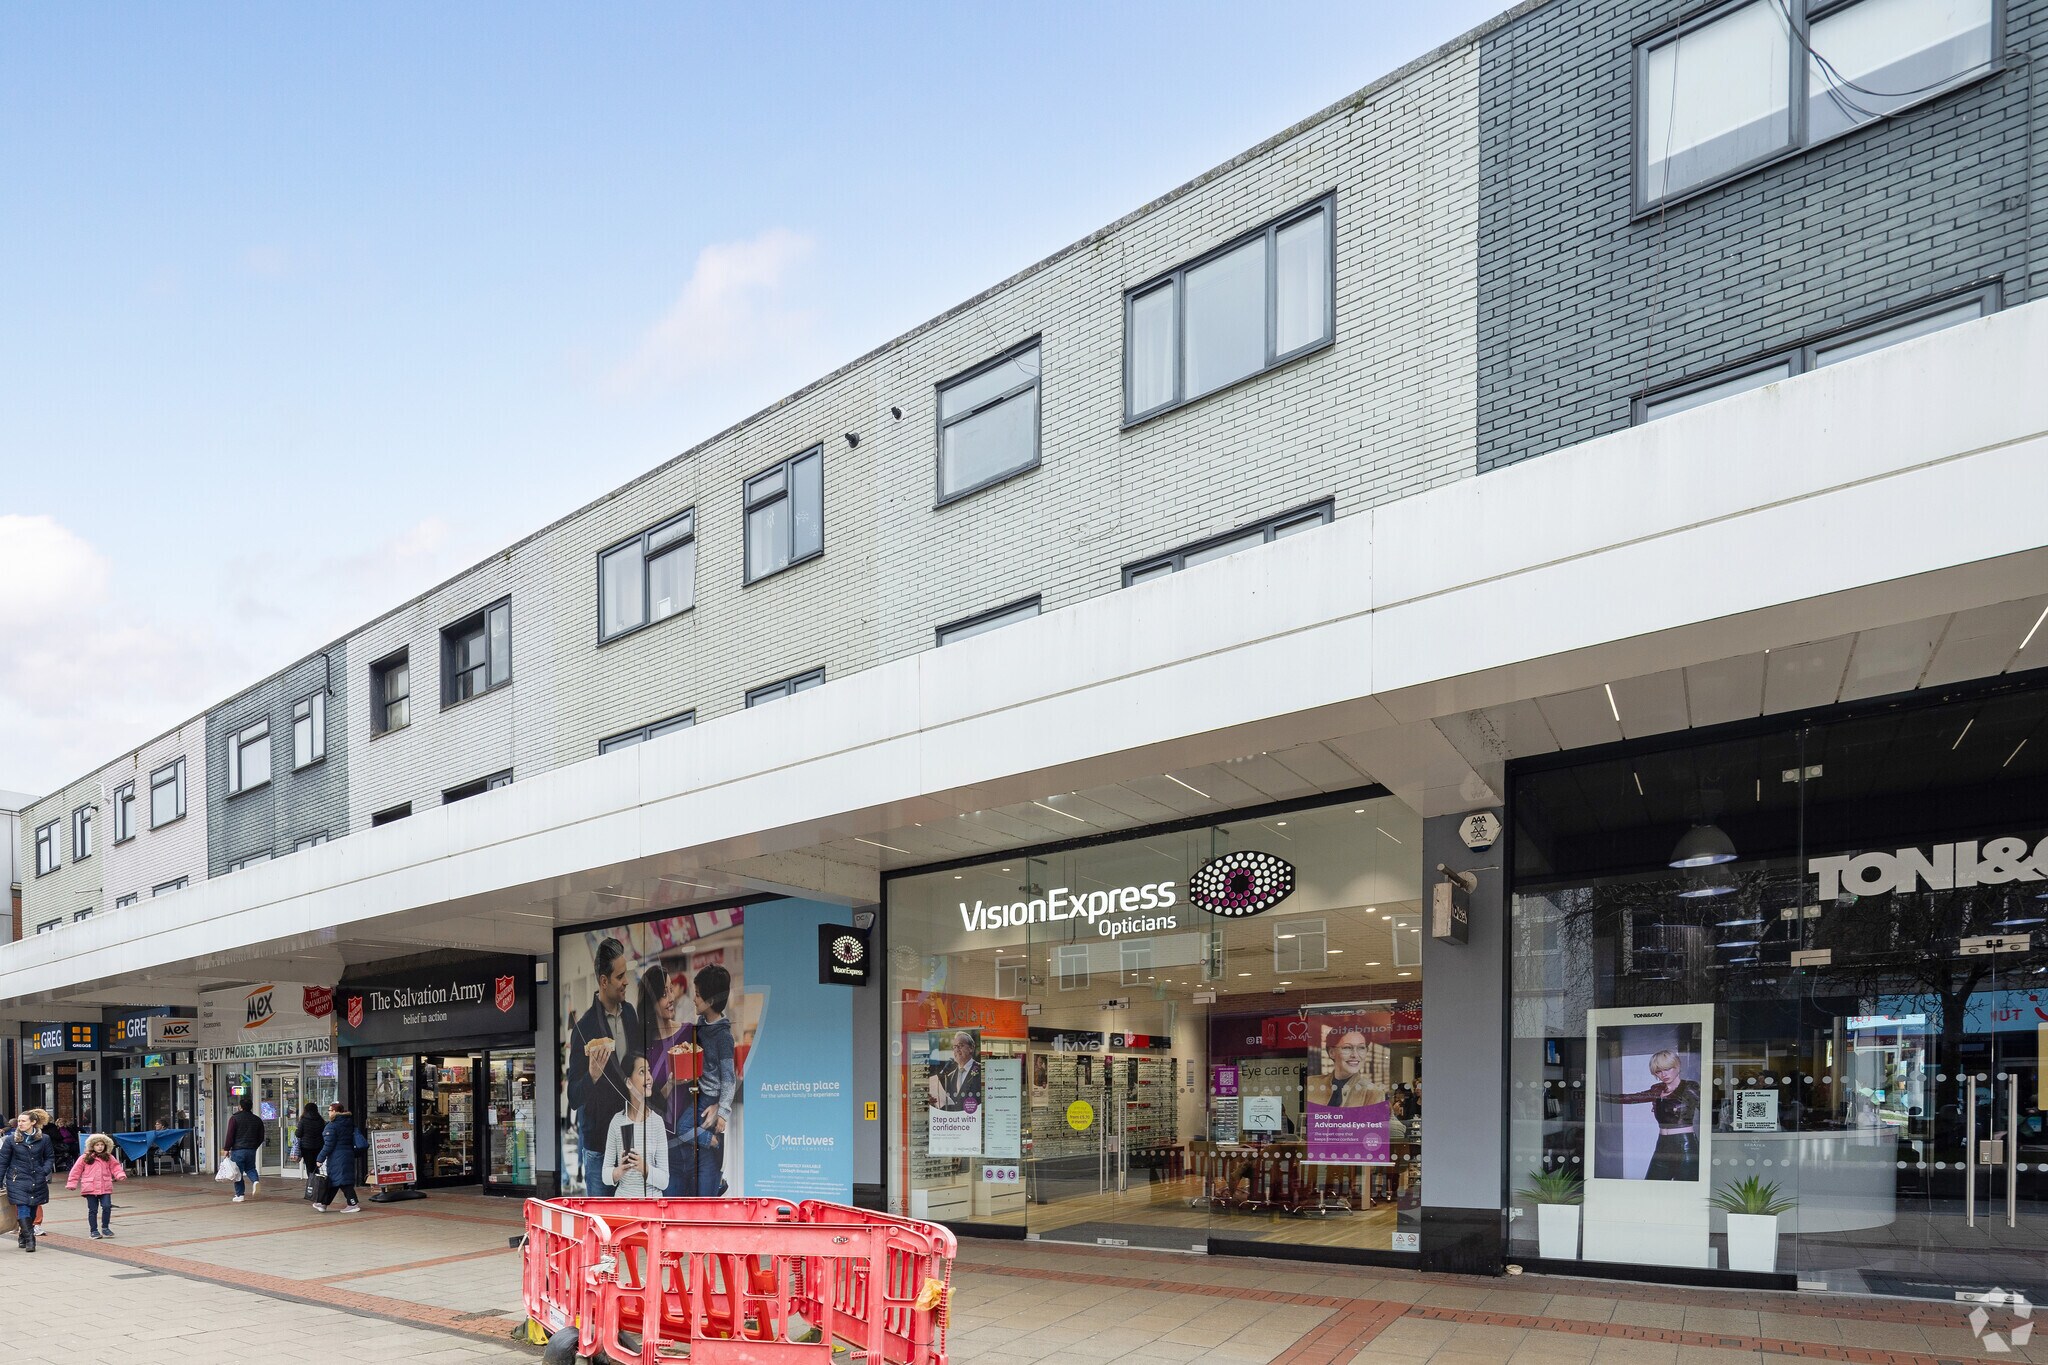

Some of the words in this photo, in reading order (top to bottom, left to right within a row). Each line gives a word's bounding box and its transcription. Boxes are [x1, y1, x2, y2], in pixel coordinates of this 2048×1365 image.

[1471, 816, 1487, 825] AAA
[1809, 837, 2048, 900] TONI&
[959, 881, 1176, 932] VisionExpress
[1098, 915, 1177, 940] Opticians
[832, 966, 864, 976] VisionExpress
[309, 990, 321, 999] THE
[369, 991, 391, 1011] The
[393, 984, 447, 1009] Salvation
[449, 981, 486, 1004] Army
[246, 991, 275, 1023] Mex
[304, 994, 332, 1010] SALVATION
[314, 1002, 330, 1014] ARMY
[403, 1013, 421, 1025] belief
[420, 1012, 428, 1023] in
[428, 1010, 448, 1022] action
[949, 999, 995, 1025] Solaris
[163, 1024, 190, 1036] Mex
[197, 1049, 208, 1062] WE
[209, 1047, 223, 1060] BUY
[225, 1044, 257, 1059] PHONES,
[258, 1041, 293, 1056] TABLETS
[296, 1040, 302, 1053] &
[304, 1037, 330, 1053] iPADS
[1241, 1065, 1261, 1079] Eye
[1264, 1065, 1290, 1075] care
[760, 1082, 773, 1092] An
[773, 1080, 811, 1093] exciting
[812, 1080, 840, 1092] place
[866, 1103, 876, 1119] H
[932, 1116, 948, 1125] Step
[1352, 1122, 1366, 1130] Eye
[781, 1135, 834, 1146] Marlowes
